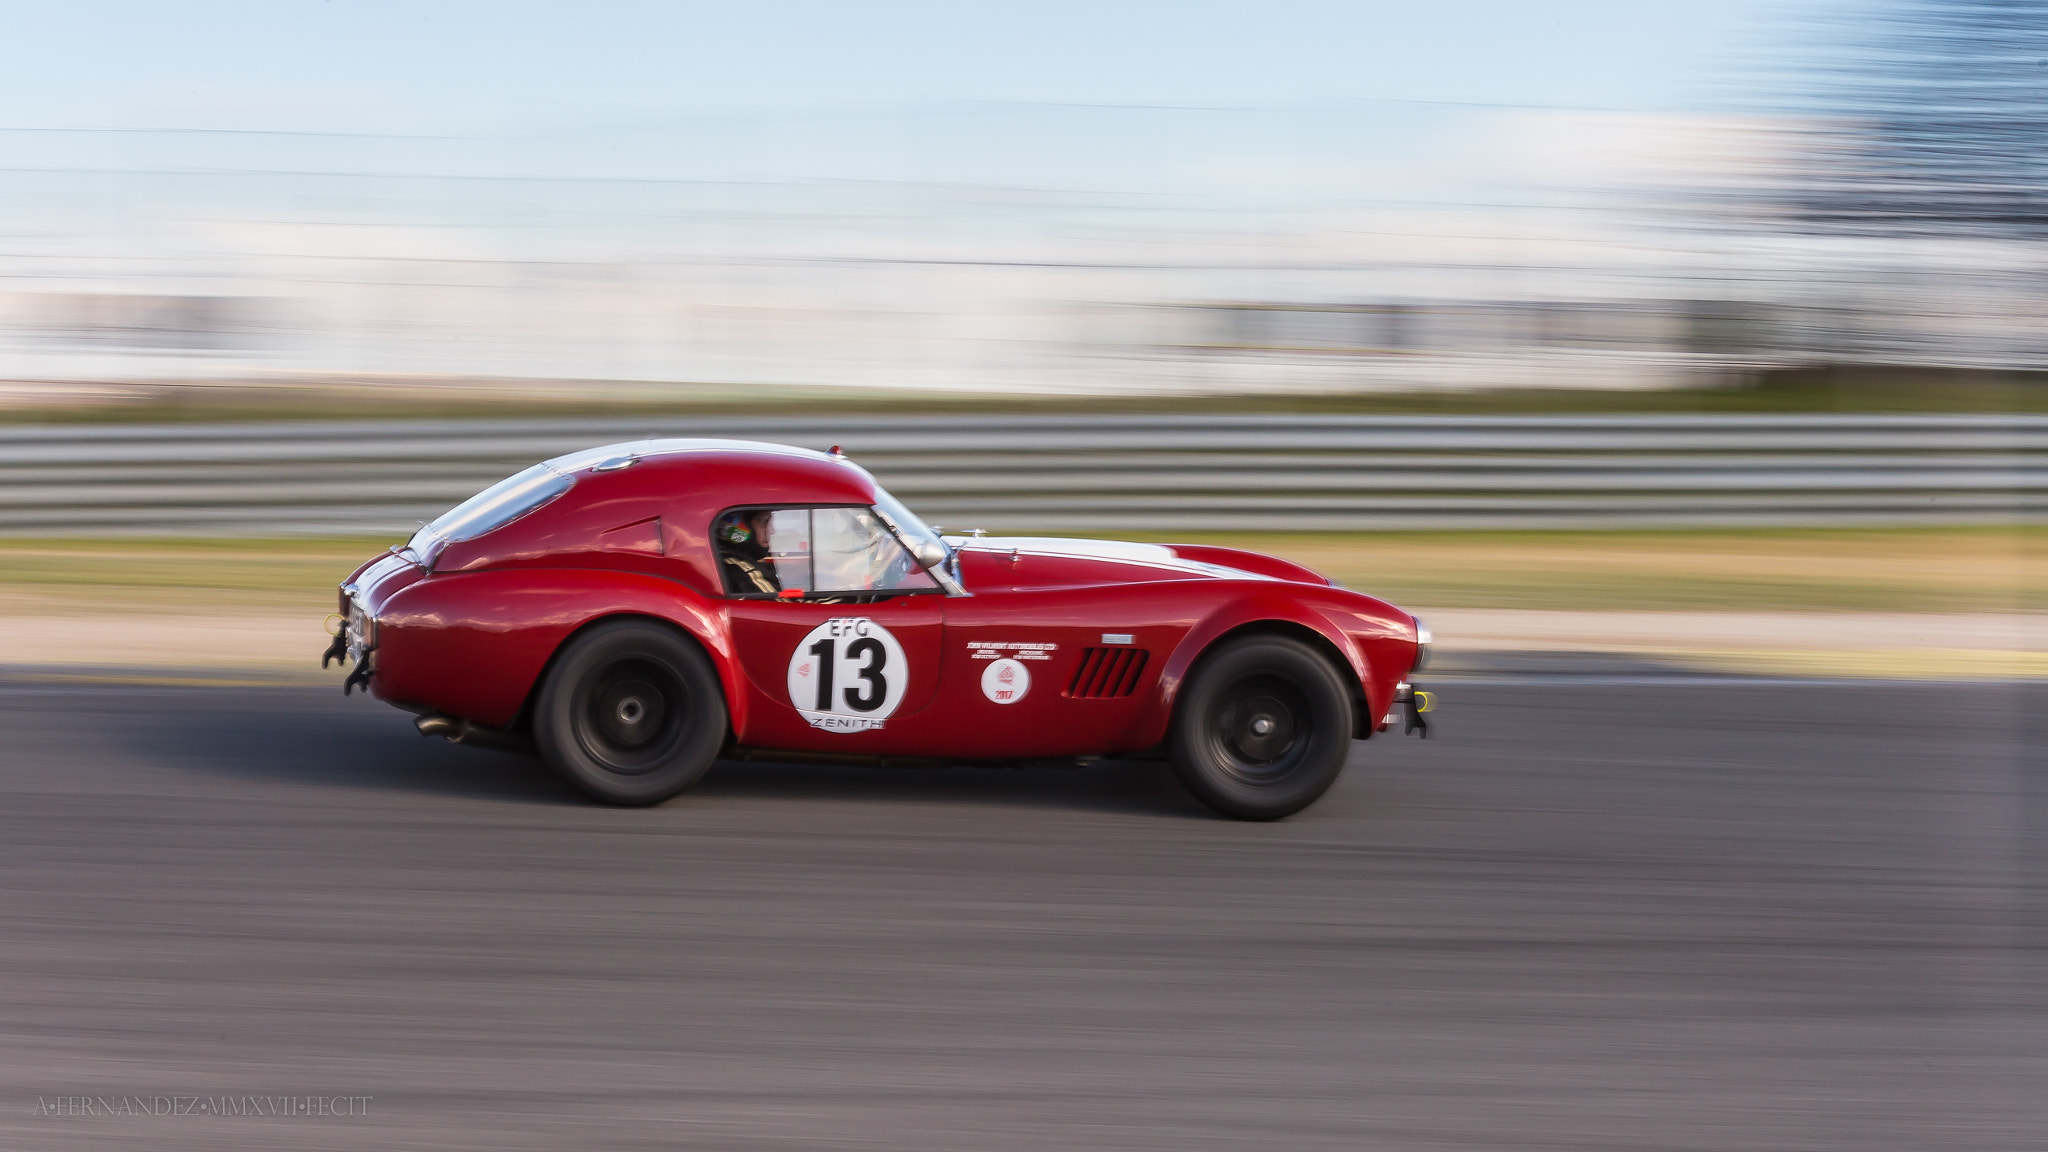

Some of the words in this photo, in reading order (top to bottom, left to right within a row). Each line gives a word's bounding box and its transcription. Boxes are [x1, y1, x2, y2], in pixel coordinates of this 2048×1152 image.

[830, 619, 869, 637] EFG
[809, 637, 887, 713] 13
[995, 690, 1014, 700] 2017
[811, 718, 885, 728] ZENITH
